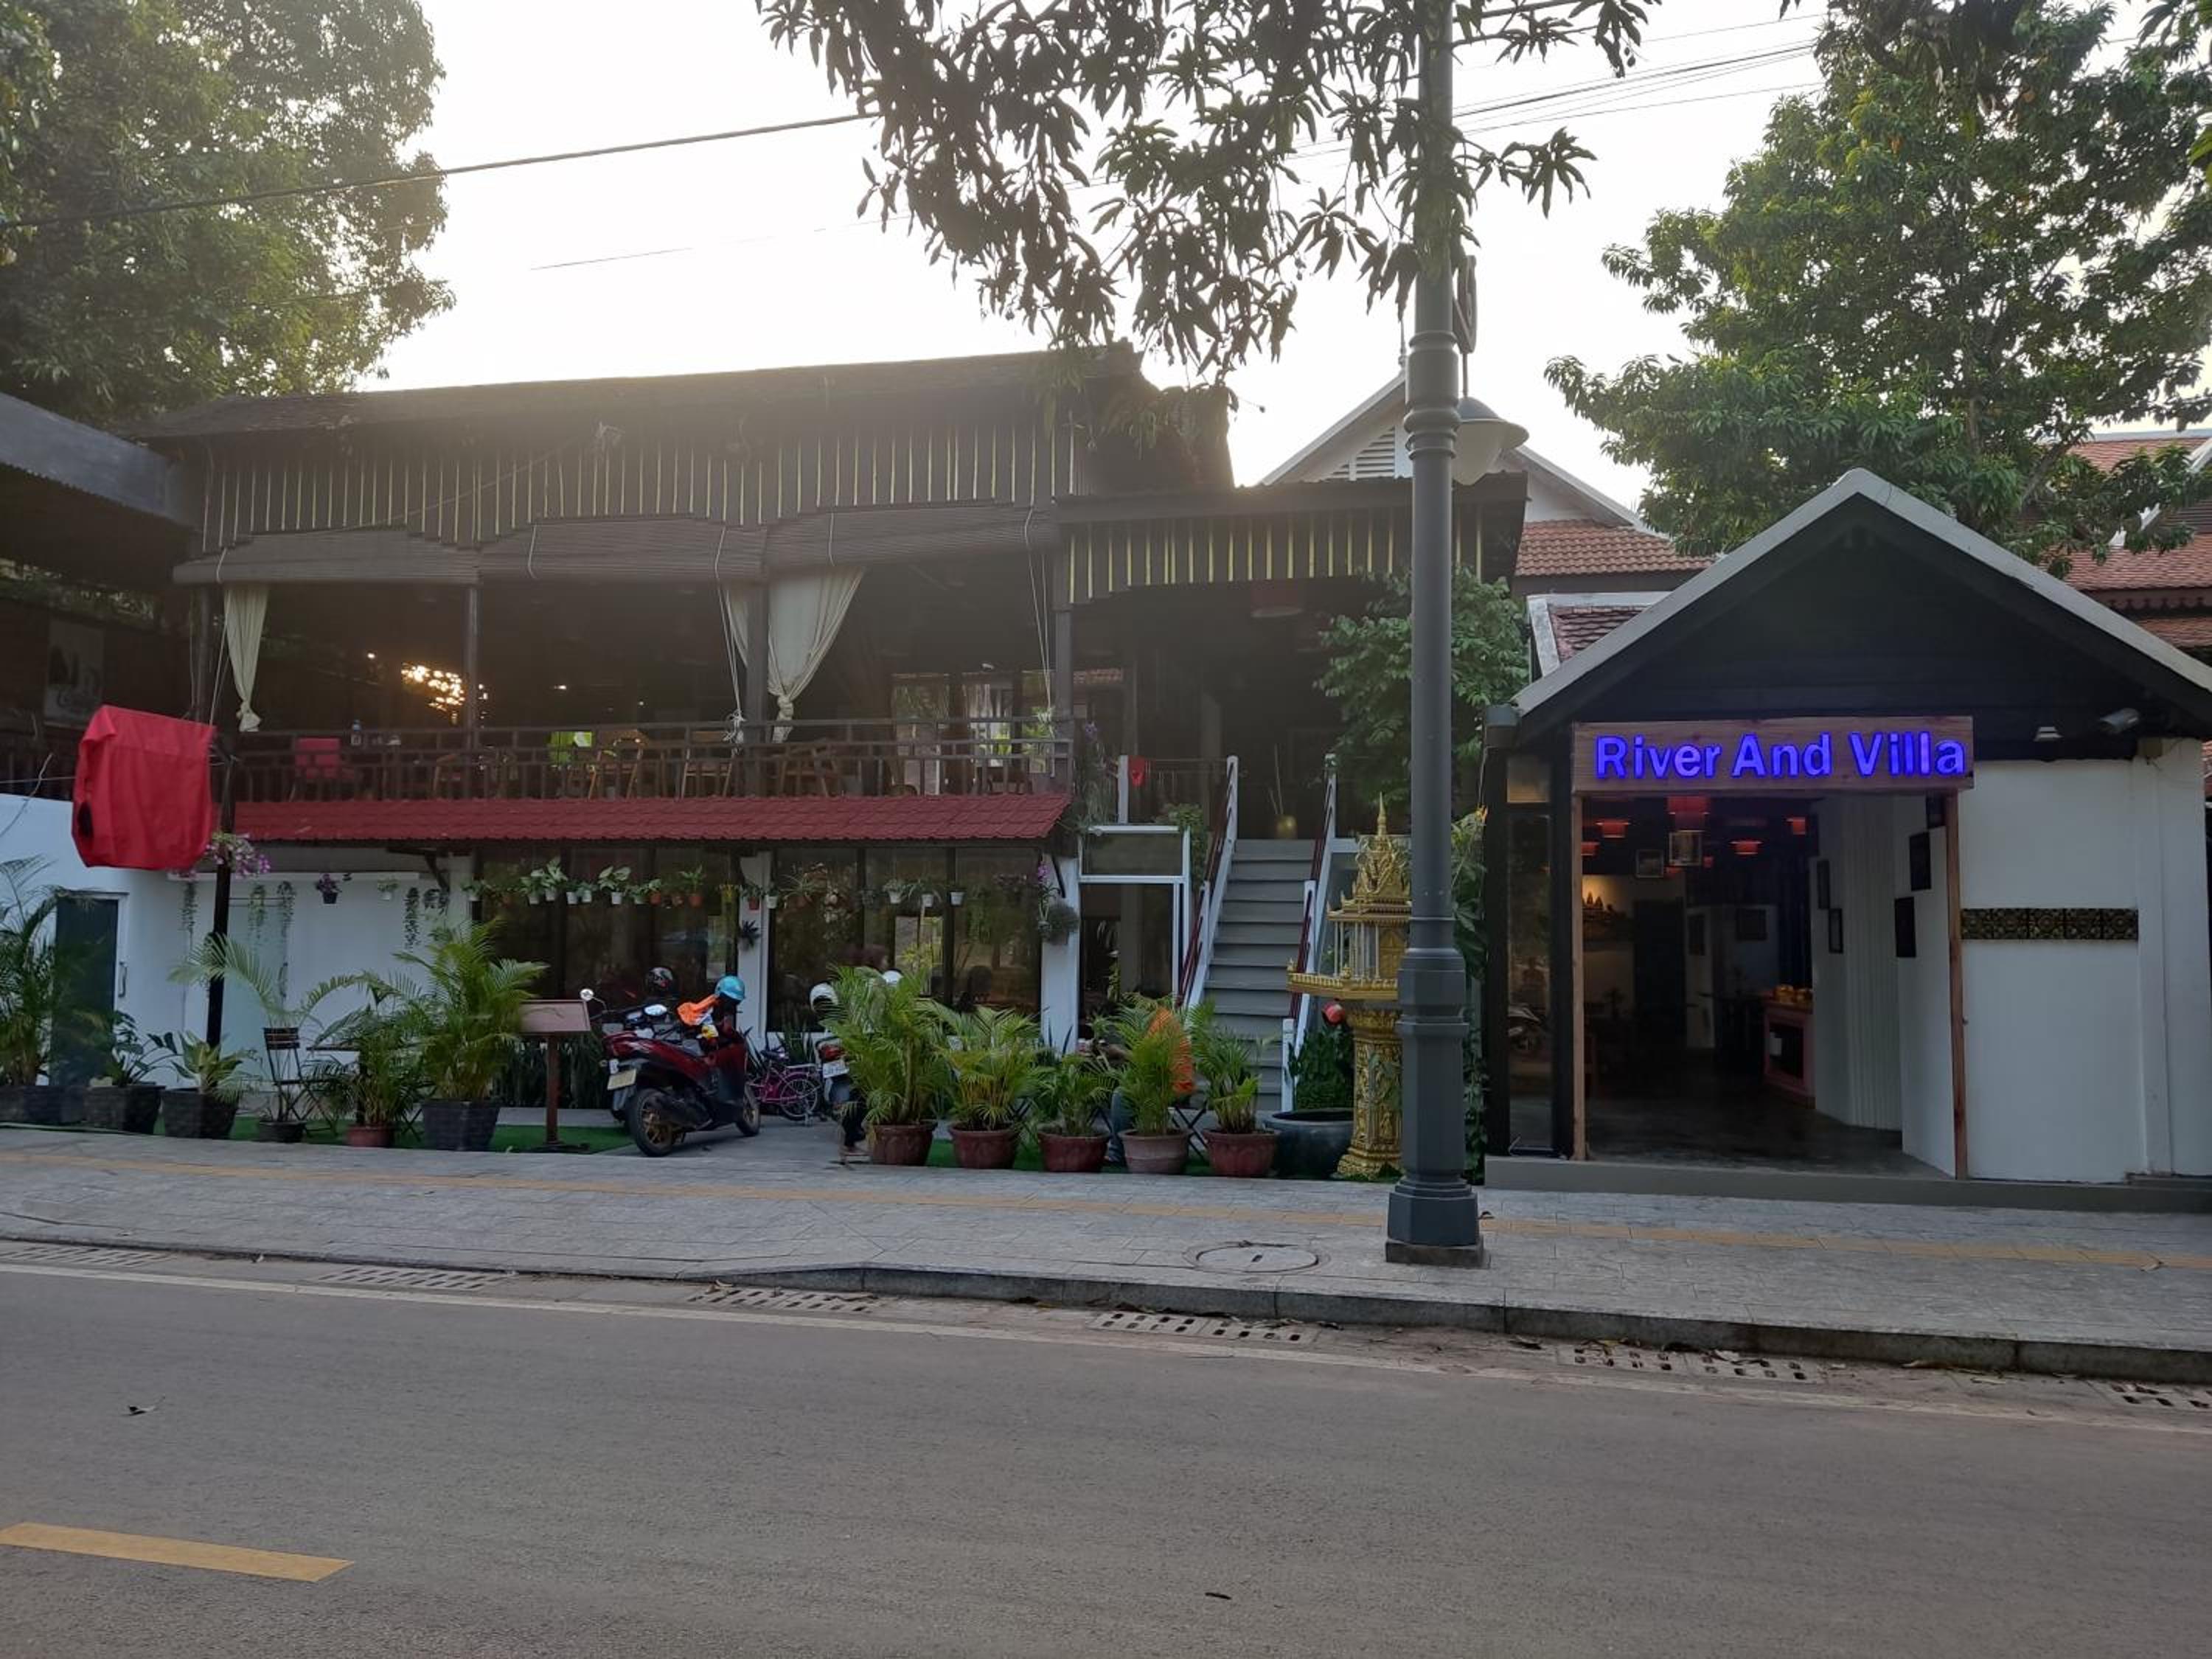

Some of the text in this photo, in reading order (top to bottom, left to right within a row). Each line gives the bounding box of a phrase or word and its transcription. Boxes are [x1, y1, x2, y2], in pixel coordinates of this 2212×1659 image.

[1595, 731, 1967, 779] River And Villa
